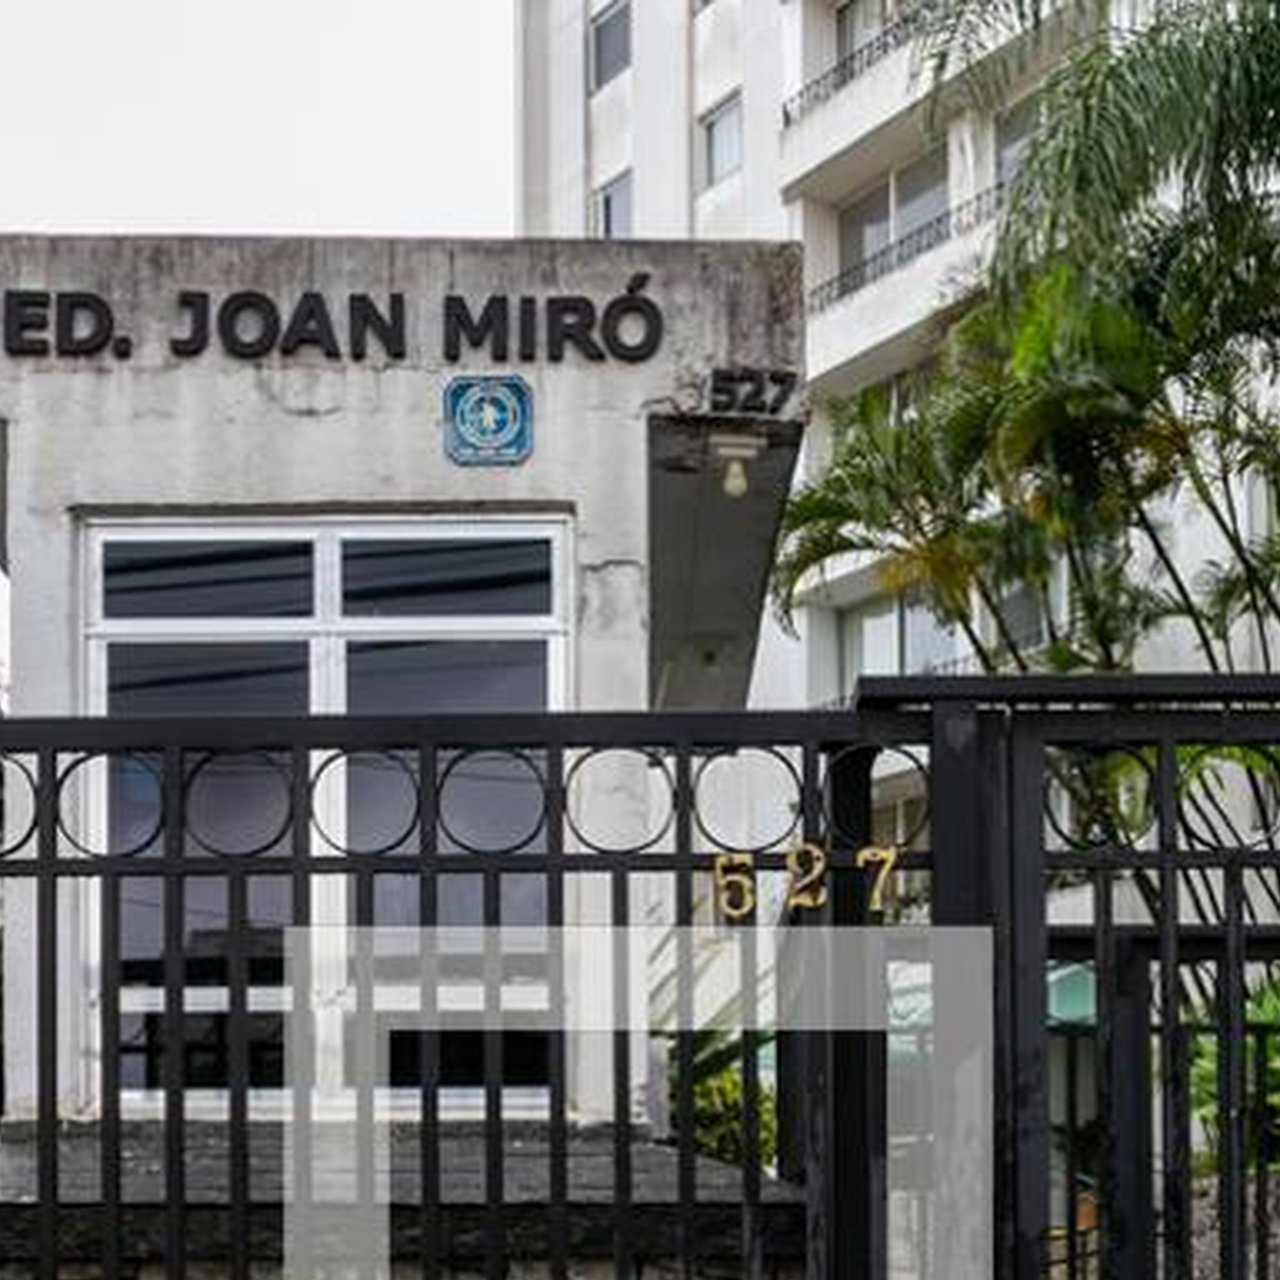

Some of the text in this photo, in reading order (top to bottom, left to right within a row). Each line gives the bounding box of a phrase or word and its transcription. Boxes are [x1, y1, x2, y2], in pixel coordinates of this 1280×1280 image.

[2, 272, 663, 362] ED. JOAN MIRÓ
[710, 367, 797, 415] 527
[713, 842, 900, 917] 527
